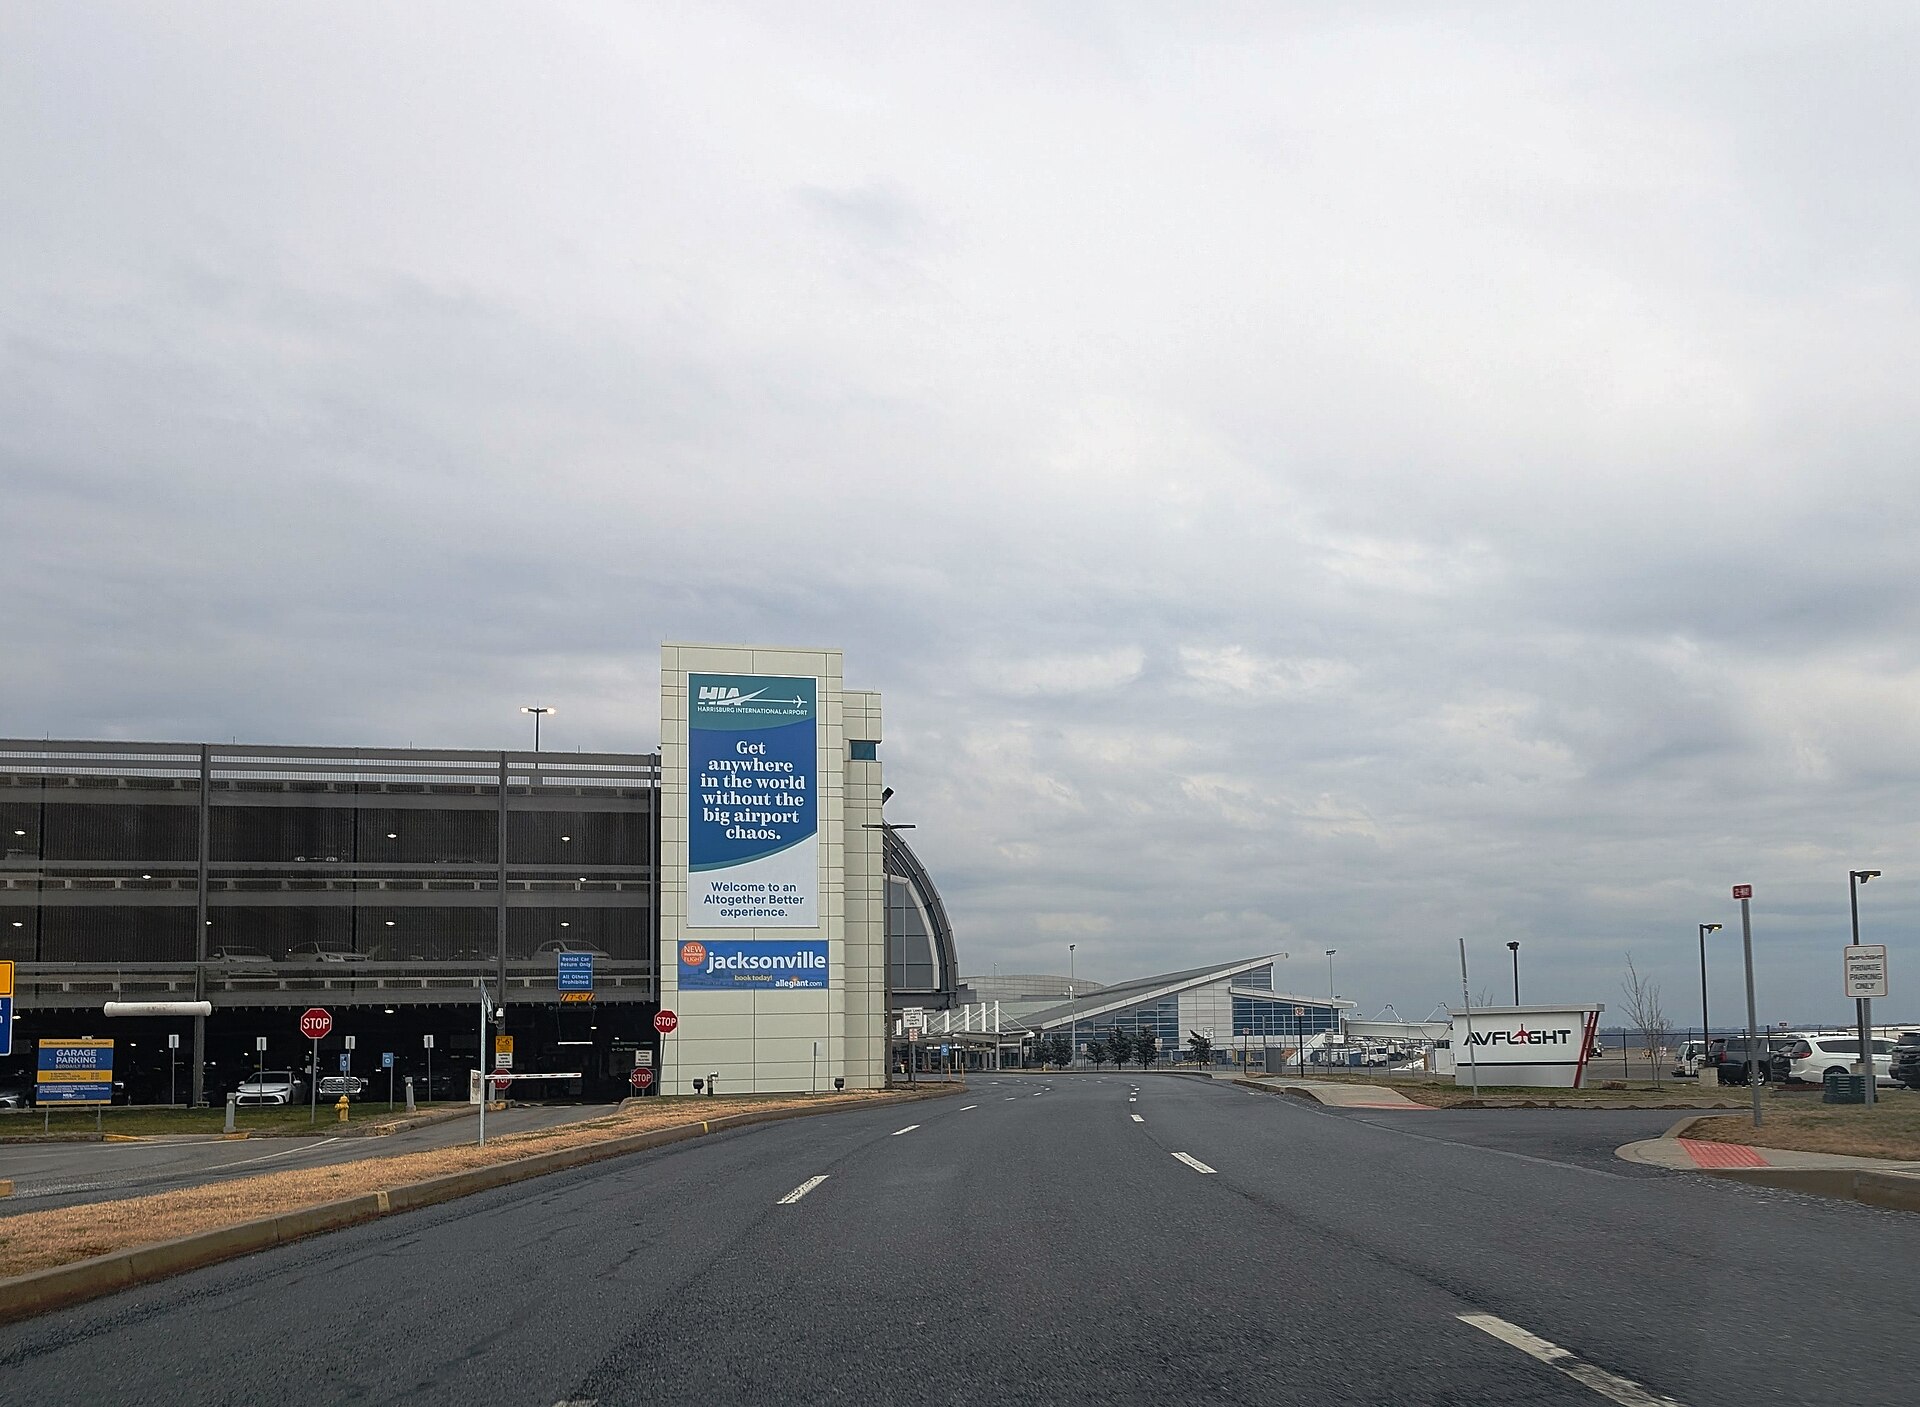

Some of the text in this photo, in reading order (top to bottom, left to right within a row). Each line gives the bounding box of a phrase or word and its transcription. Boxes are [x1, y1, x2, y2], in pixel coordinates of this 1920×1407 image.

[697, 686, 741, 706] HIA
[735, 707, 782, 715] INTERNATIONAL
[736, 740, 766, 755] Get
[708, 757, 794, 773] anywhere
[700, 772, 806, 790] in the world
[702, 791, 804, 806] without the
[703, 807, 800, 826] big airport
[725, 825, 781, 840] chaos.
[711, 882, 796, 892] Welcome to an
[703, 894, 805, 906] Altogether Better
[720, 907, 788, 918] experience.
[683, 945, 703, 953] NEW
[706, 951, 826, 974] jacksonville
[775, 978, 823, 988] allegiant.com
[303, 1018, 330, 1029] STOP
[655, 1017, 677, 1027] STOP
[56, 1049, 97, 1057] GARAGE
[56, 1056, 97, 1064] PARKING
[632, 1074, 652, 1082] STOP
